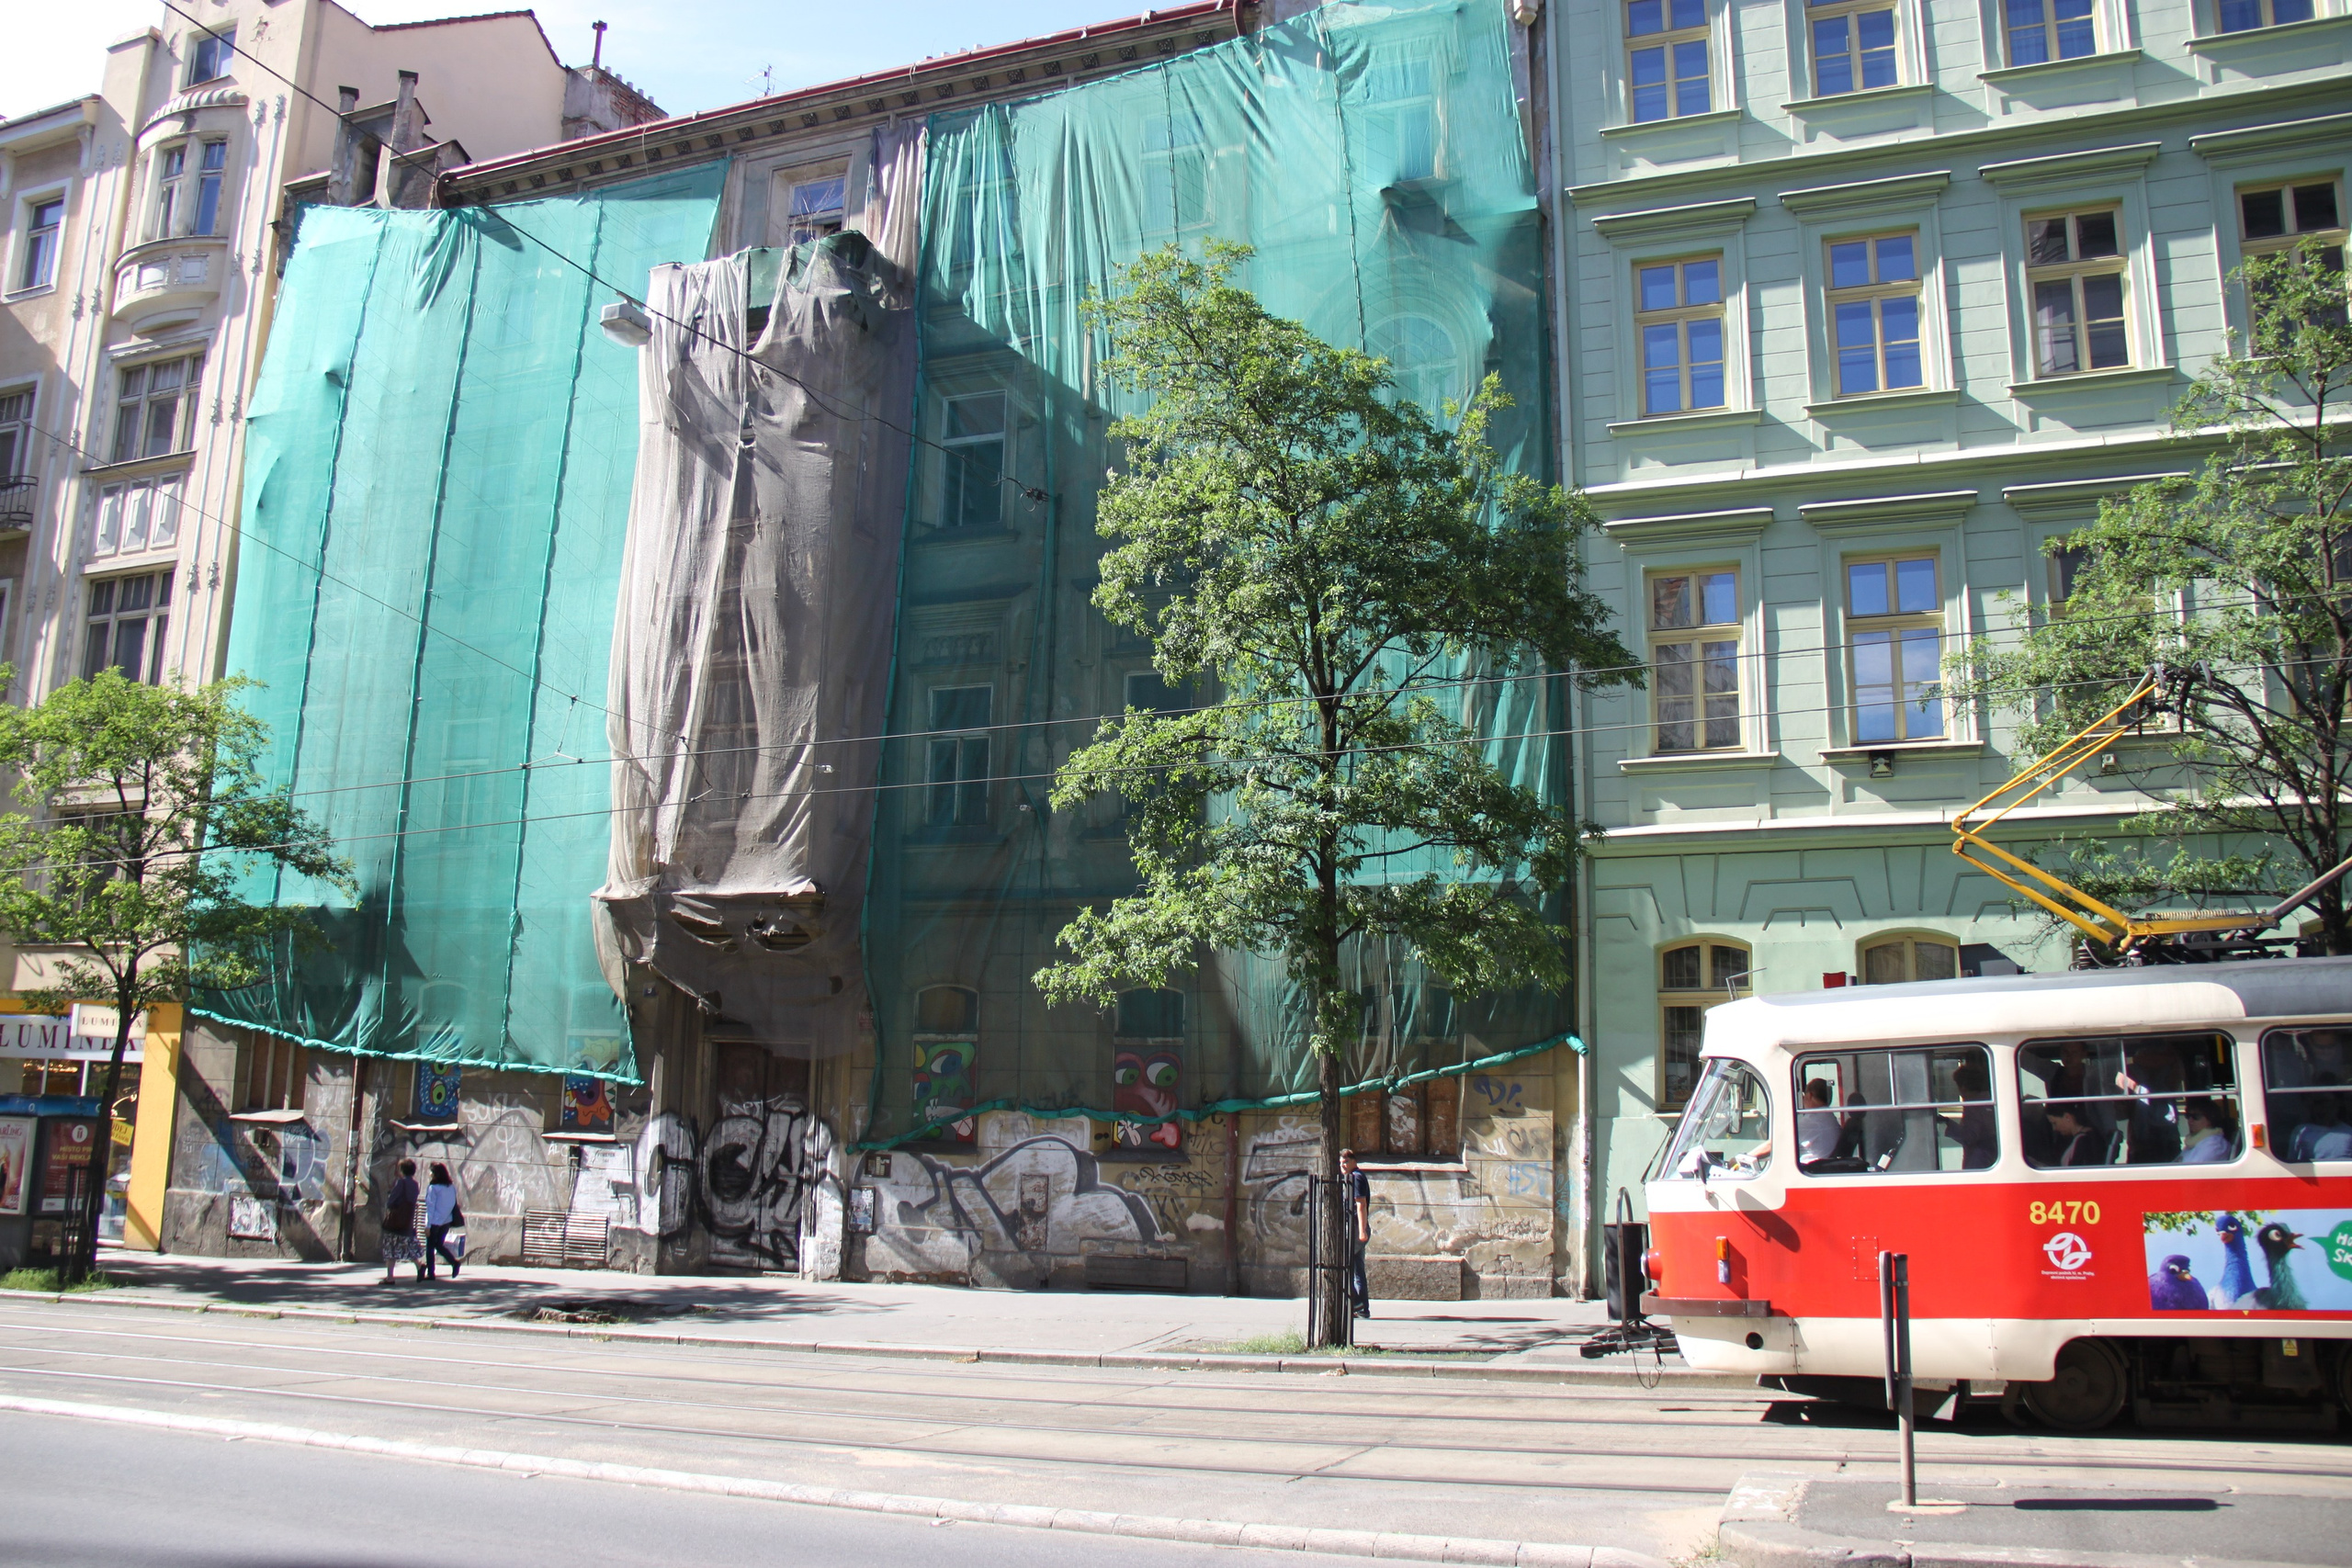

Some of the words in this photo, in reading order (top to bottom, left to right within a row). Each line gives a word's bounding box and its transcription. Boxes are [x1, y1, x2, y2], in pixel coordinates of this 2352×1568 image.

[81, 1016, 144, 1029] LUMIX
[69, 1154, 92, 1162] REKLA
[2029, 1200, 2101, 1225] 8470
